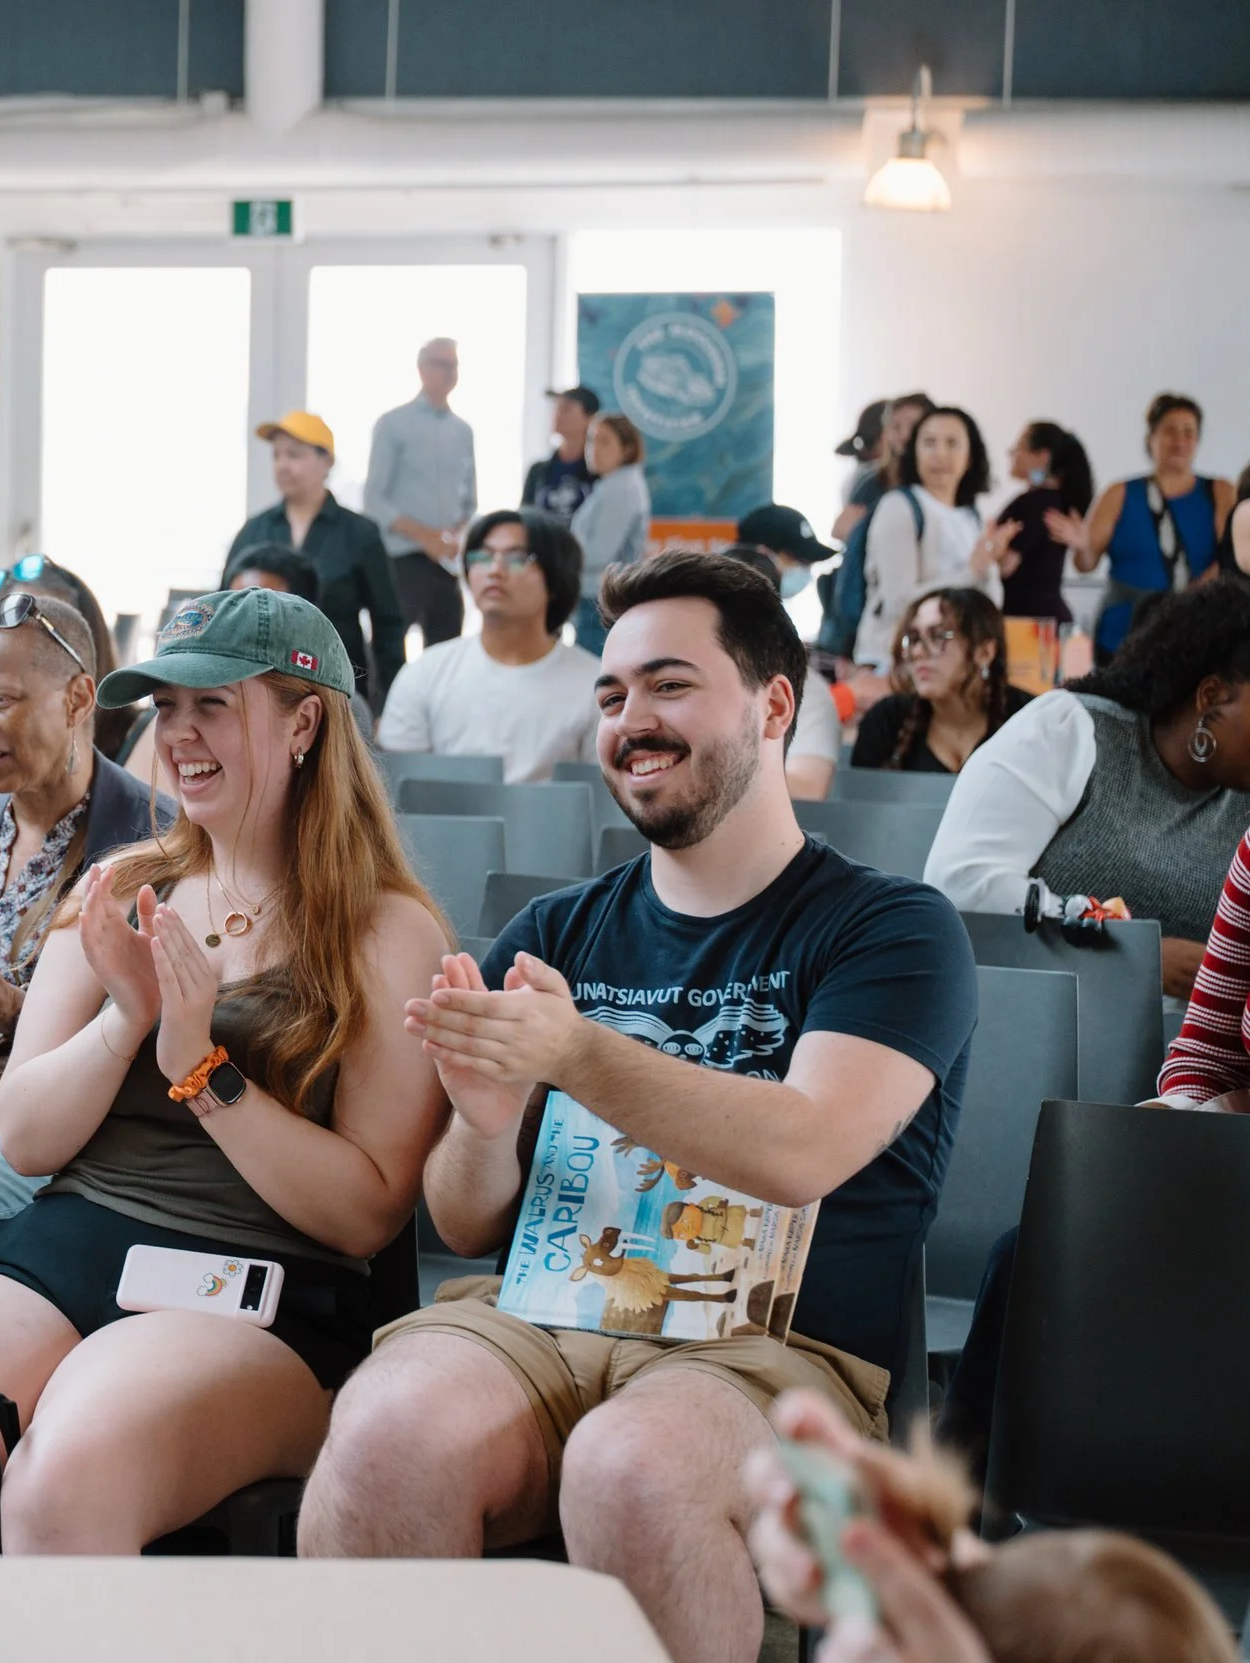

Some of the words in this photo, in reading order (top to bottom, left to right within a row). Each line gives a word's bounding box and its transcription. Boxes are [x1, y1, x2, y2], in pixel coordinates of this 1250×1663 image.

[572, 982, 684, 1006] UNATSIAVUT
[688, 971, 791, 1007] GOVERENT
[550, 1119, 564, 1142] THE
[543, 1145, 558, 1169] AND
[519, 1173, 555, 1255] WALRUS
[543, 1135, 600, 1272] CARIBOU
[516, 1260, 530, 1285] THE
